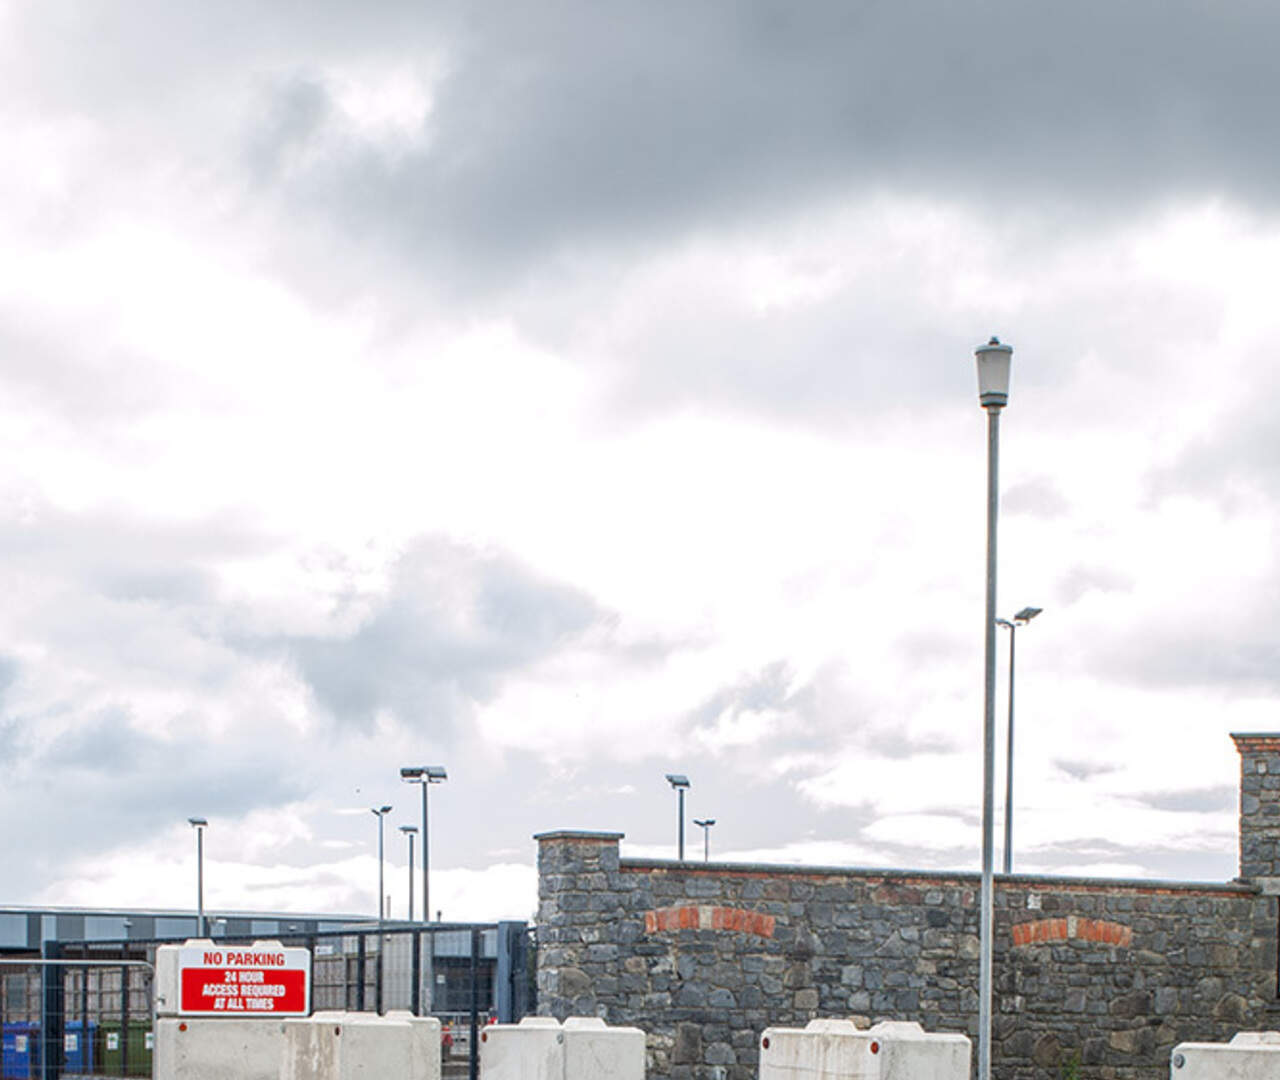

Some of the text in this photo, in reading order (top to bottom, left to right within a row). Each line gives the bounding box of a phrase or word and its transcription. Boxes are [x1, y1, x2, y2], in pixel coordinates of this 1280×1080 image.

[203, 952, 285, 966] NO PARKING
[224, 971, 264, 983] 24 HOUR
[202, 984, 286, 997] ACCESS REQUIRED
[213, 998, 274, 1010] AT ALL TIMES
